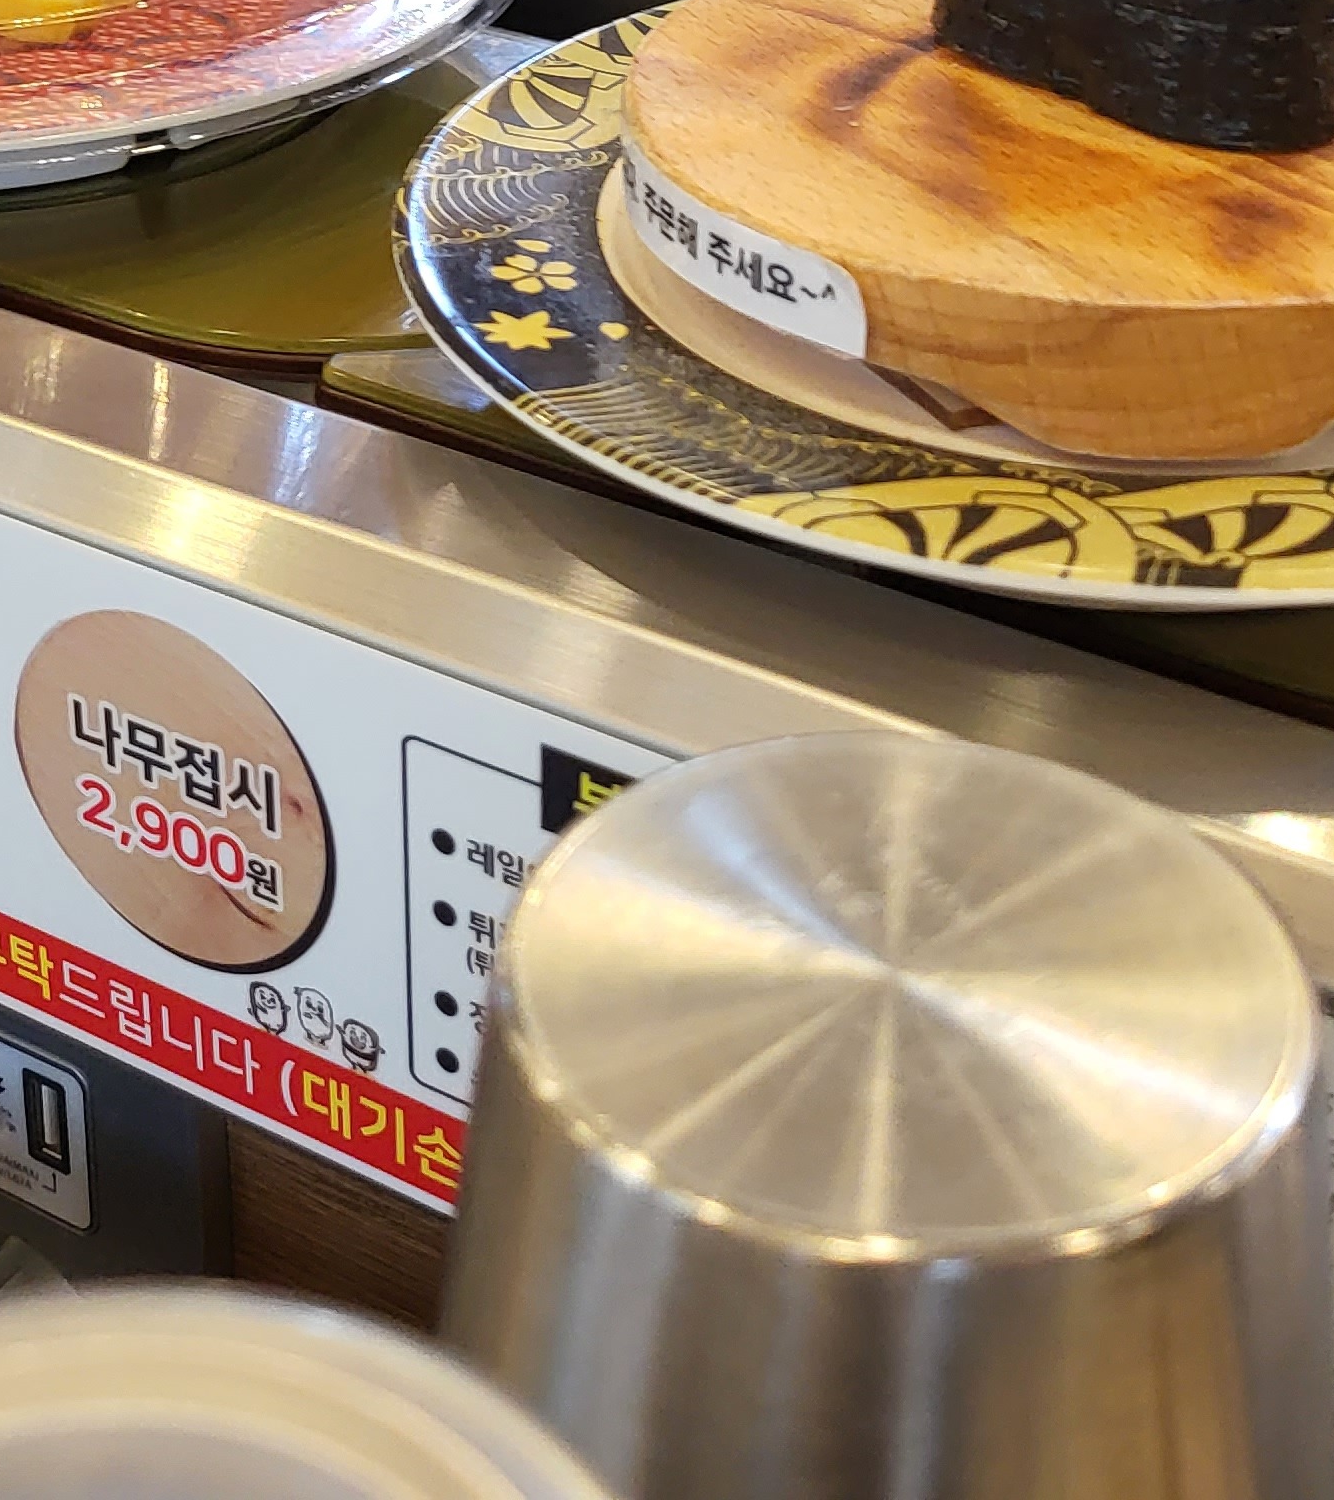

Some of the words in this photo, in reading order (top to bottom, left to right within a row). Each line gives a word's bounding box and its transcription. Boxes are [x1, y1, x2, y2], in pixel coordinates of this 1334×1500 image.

[643, 182, 698, 260] 주문해
[72, 698, 276, 833] 나무접시
[80, 779, 279, 906] 2,900원
[466, 837, 537, 888] 레일
[469, 910, 509, 950] 튀
